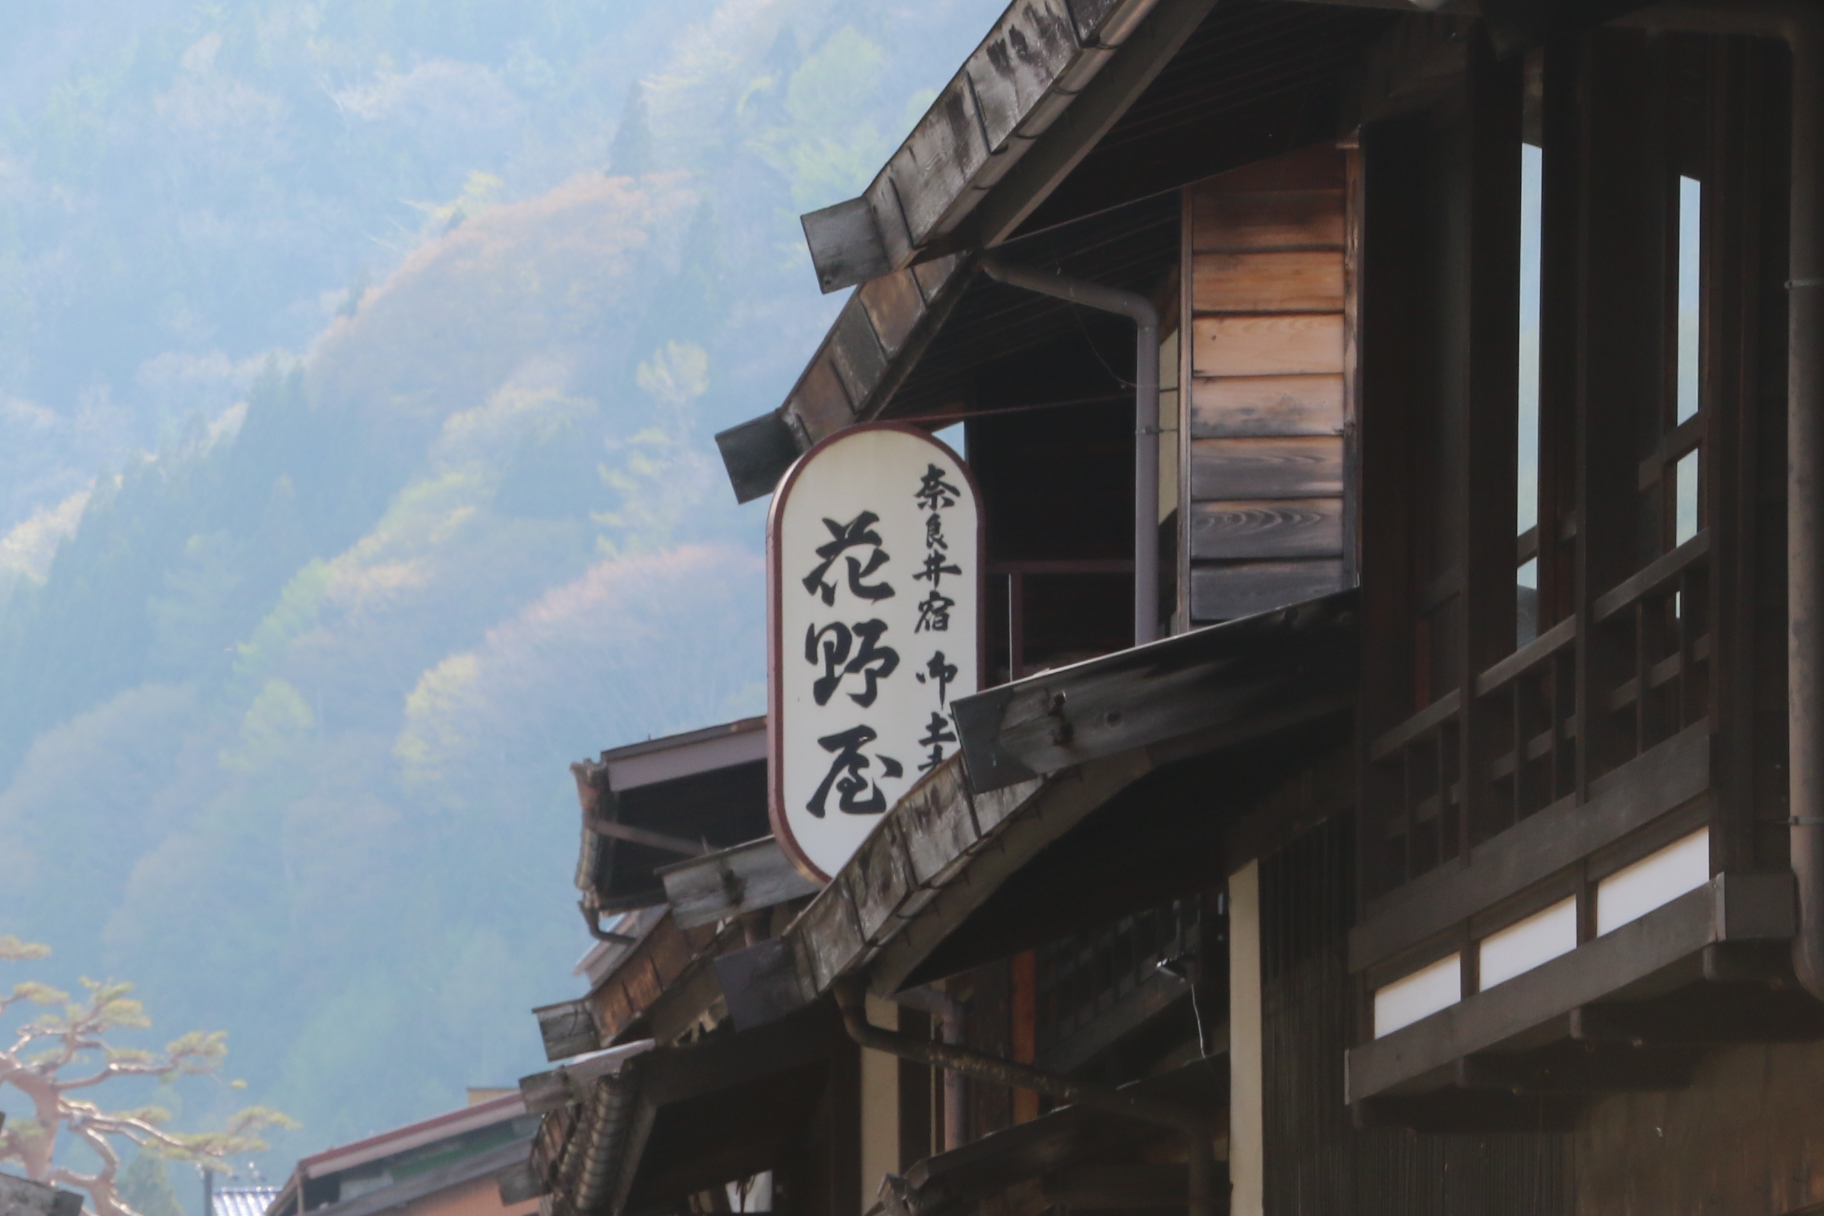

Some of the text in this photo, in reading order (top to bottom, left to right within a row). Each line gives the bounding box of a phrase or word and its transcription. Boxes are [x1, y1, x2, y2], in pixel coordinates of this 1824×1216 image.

[802, 510, 903, 818] 花野屋
[912, 463, 962, 634] 奈良井宿
